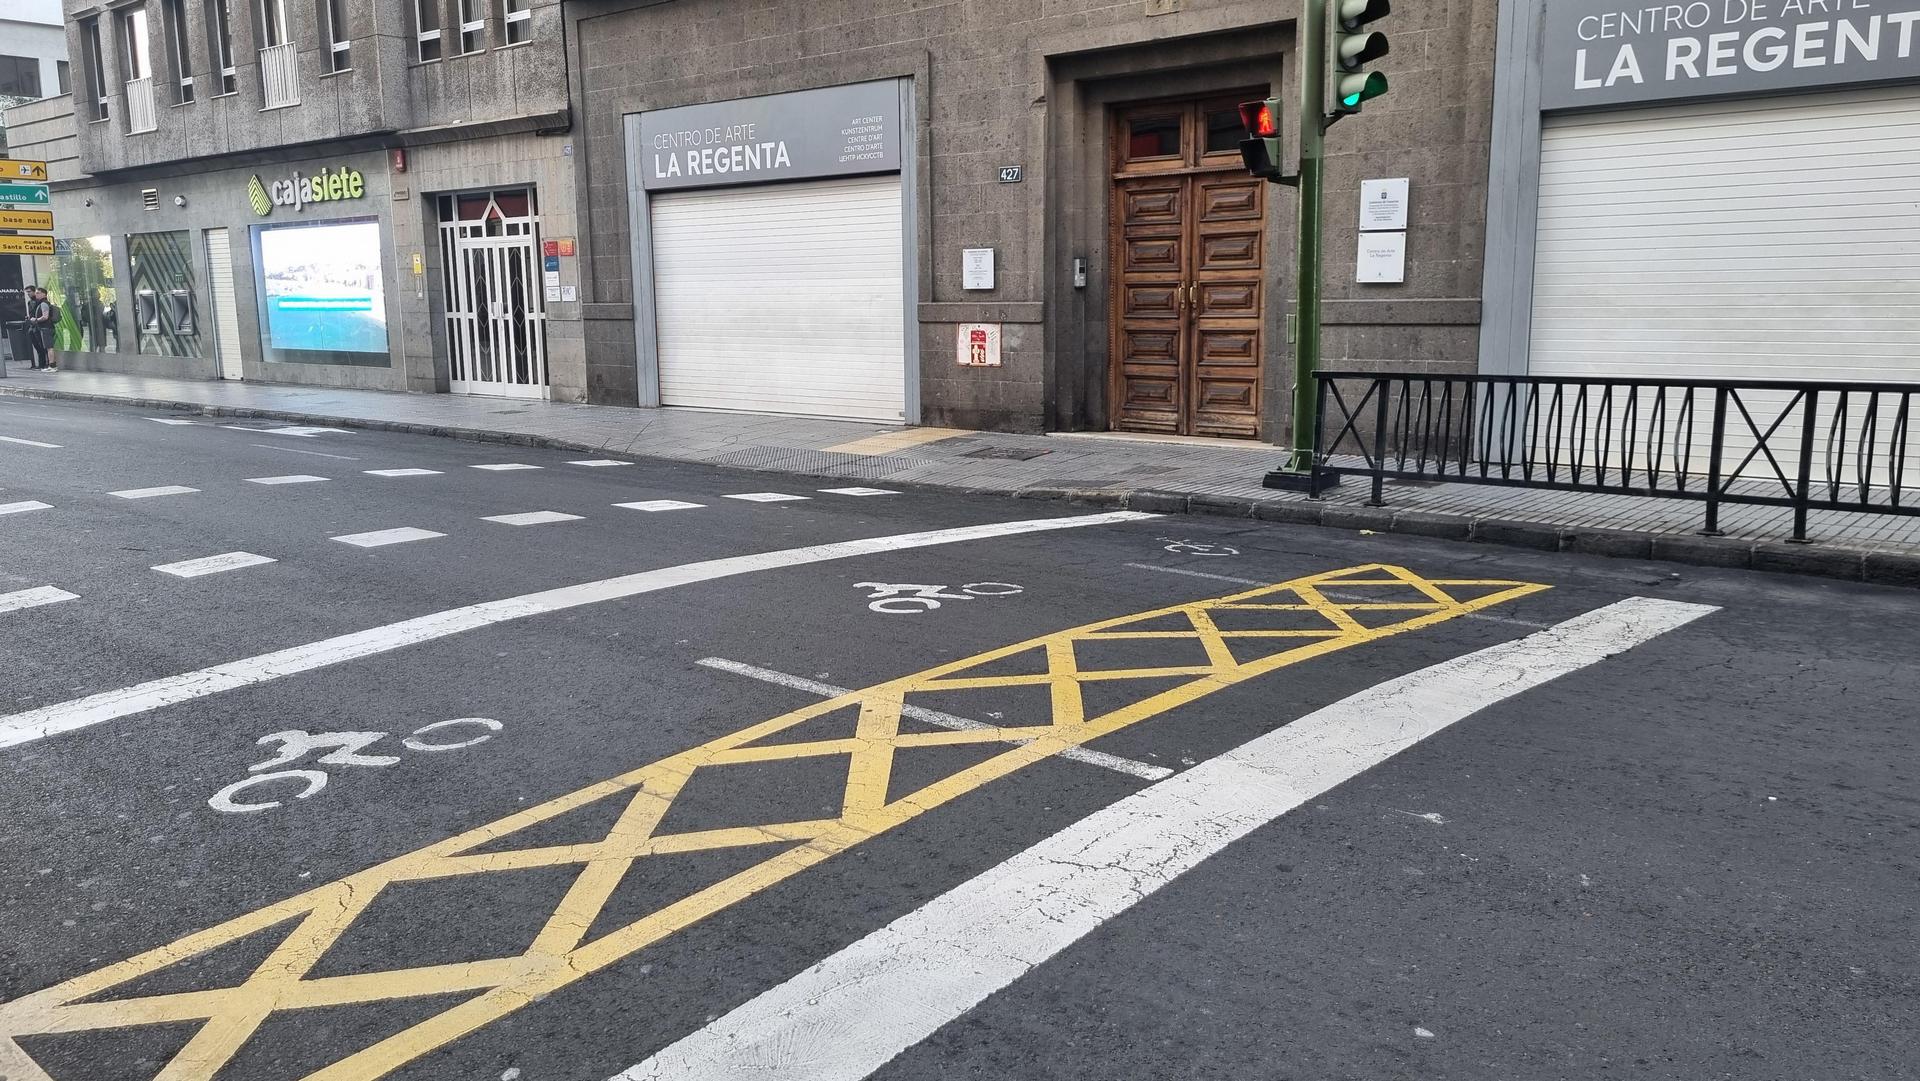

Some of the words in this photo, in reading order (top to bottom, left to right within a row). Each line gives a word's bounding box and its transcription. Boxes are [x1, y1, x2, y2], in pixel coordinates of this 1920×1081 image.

[1577, 2, 1710, 41] CENTRO
[1724, 0, 1767, 24] DE
[1574, 43, 1644, 90] LA
[1665, 10, 1920, 81] REGENT
[654, 129, 702, 149] CENTRO
[705, 127, 721, 145] DE
[725, 123, 756, 142] ARTE
[655, 152, 681, 178] LA
[687, 141, 791, 176] REGENTA
[1001, 168, 1019, 180] 427
[272, 166, 365, 212] cajasiete
[27, 217, 50, 225] naval
